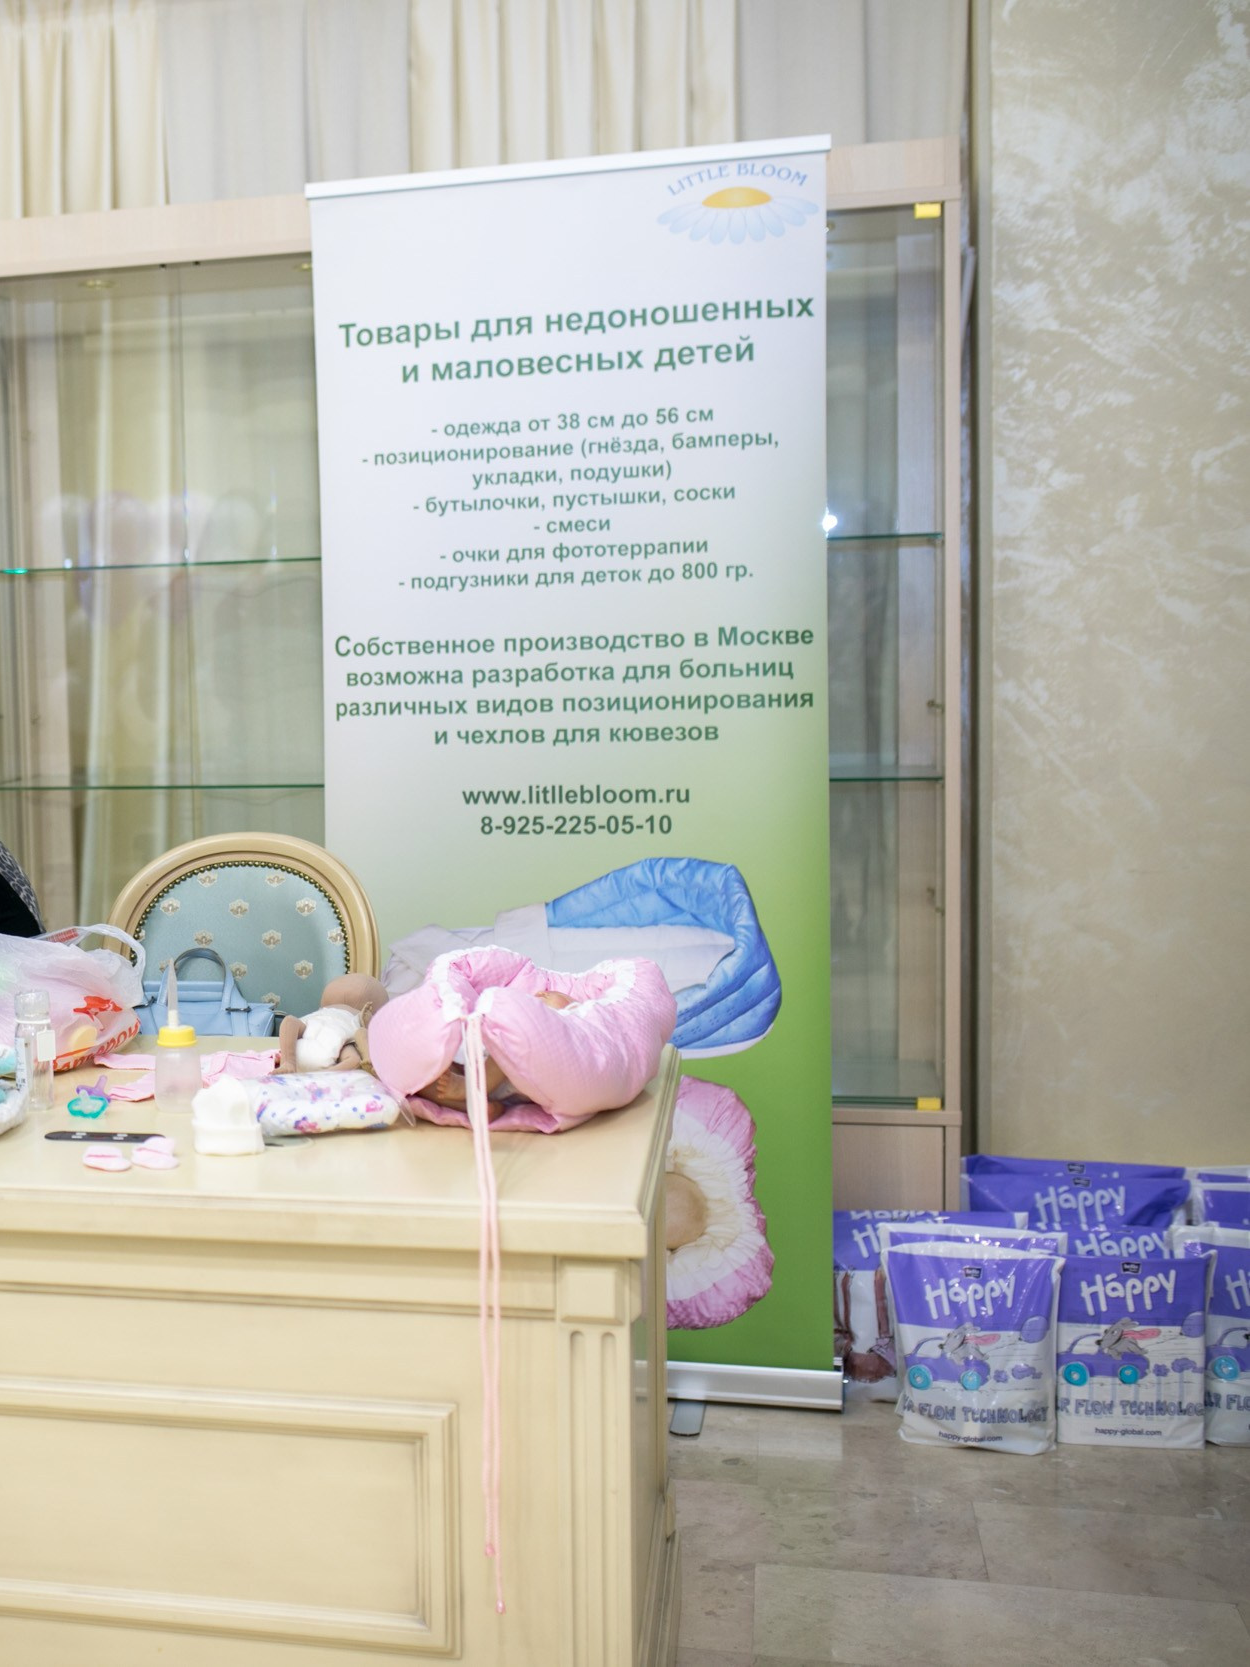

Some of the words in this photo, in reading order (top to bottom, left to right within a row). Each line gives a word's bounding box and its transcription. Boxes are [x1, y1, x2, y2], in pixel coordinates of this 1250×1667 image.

[667, 164, 730, 196] LITTLE
[736, 162, 809, 187] BLOOM
[338, 320, 460, 349] Товары
[470, 316, 533, 343] для
[545, 297, 814, 341] недоношенных
[402, 364, 419, 383] и
[432, 349, 644, 381] маловесных
[654, 335, 754, 372] детей
[444, 420, 521, 438] одежда
[528, 418, 550, 432] от
[558, 413, 580, 430] 38
[587, 415, 614, 429] см
[621, 413, 648, 430] до
[656, 407, 679, 425] 56
[686, 408, 713, 423] см
[374, 443, 574, 465] позиционирование
[581, 437, 664, 459] (гнёзда,
[672, 432, 778, 450] бамперы,
[472, 470, 562, 490] укладки,
[570, 460, 672, 484] подушки)
[425, 496, 545, 517] бутылочки,
[553, 490, 666, 511] пустышки,
[674, 486, 735, 502] соски
[546, 519, 610, 534] смеси
[452, 549, 500, 563] очки
[506, 547, 545, 564] для
[552, 540, 708, 563] фототеррапии
[411, 573, 529, 592] подгузники
[535, 571, 574, 588] для
[581, 569, 642, 586] деток
[648, 568, 675, 584] до
[682, 562, 718, 580] 800
[726, 564, 753, 582] гр.
[335, 635, 495, 657] Собственное
[504, 632, 685, 657] производство
[694, 632, 709, 647] в
[718, 626, 814, 646] Москве
[347, 669, 463, 687] возможна
[472, 662, 615, 689] разработка
[622, 664, 670, 683] для
[679, 658, 794, 680] больниц
[336, 700, 468, 721] различных
[477, 698, 554, 717] видов
[563, 692, 814, 715] позиционирования
[434, 730, 448, 745] и
[457, 728, 545, 744] чехлов
[552, 728, 600, 747] для
[610, 726, 719, 742] кювезов
[462, 784, 690, 805] www.litllebloom.ru
[481, 815, 672, 835] 8-925-225-05-10
[918, 1402, 956, 1421] FLOW
[962, 1405, 1050, 1424] TECHNOLOGY
[1075, 1398, 1115, 1415] FLOW
[938, 1430, 1004, 1443] happy-global.com
[1095, 1427, 1163, 1437] happy-global.com
